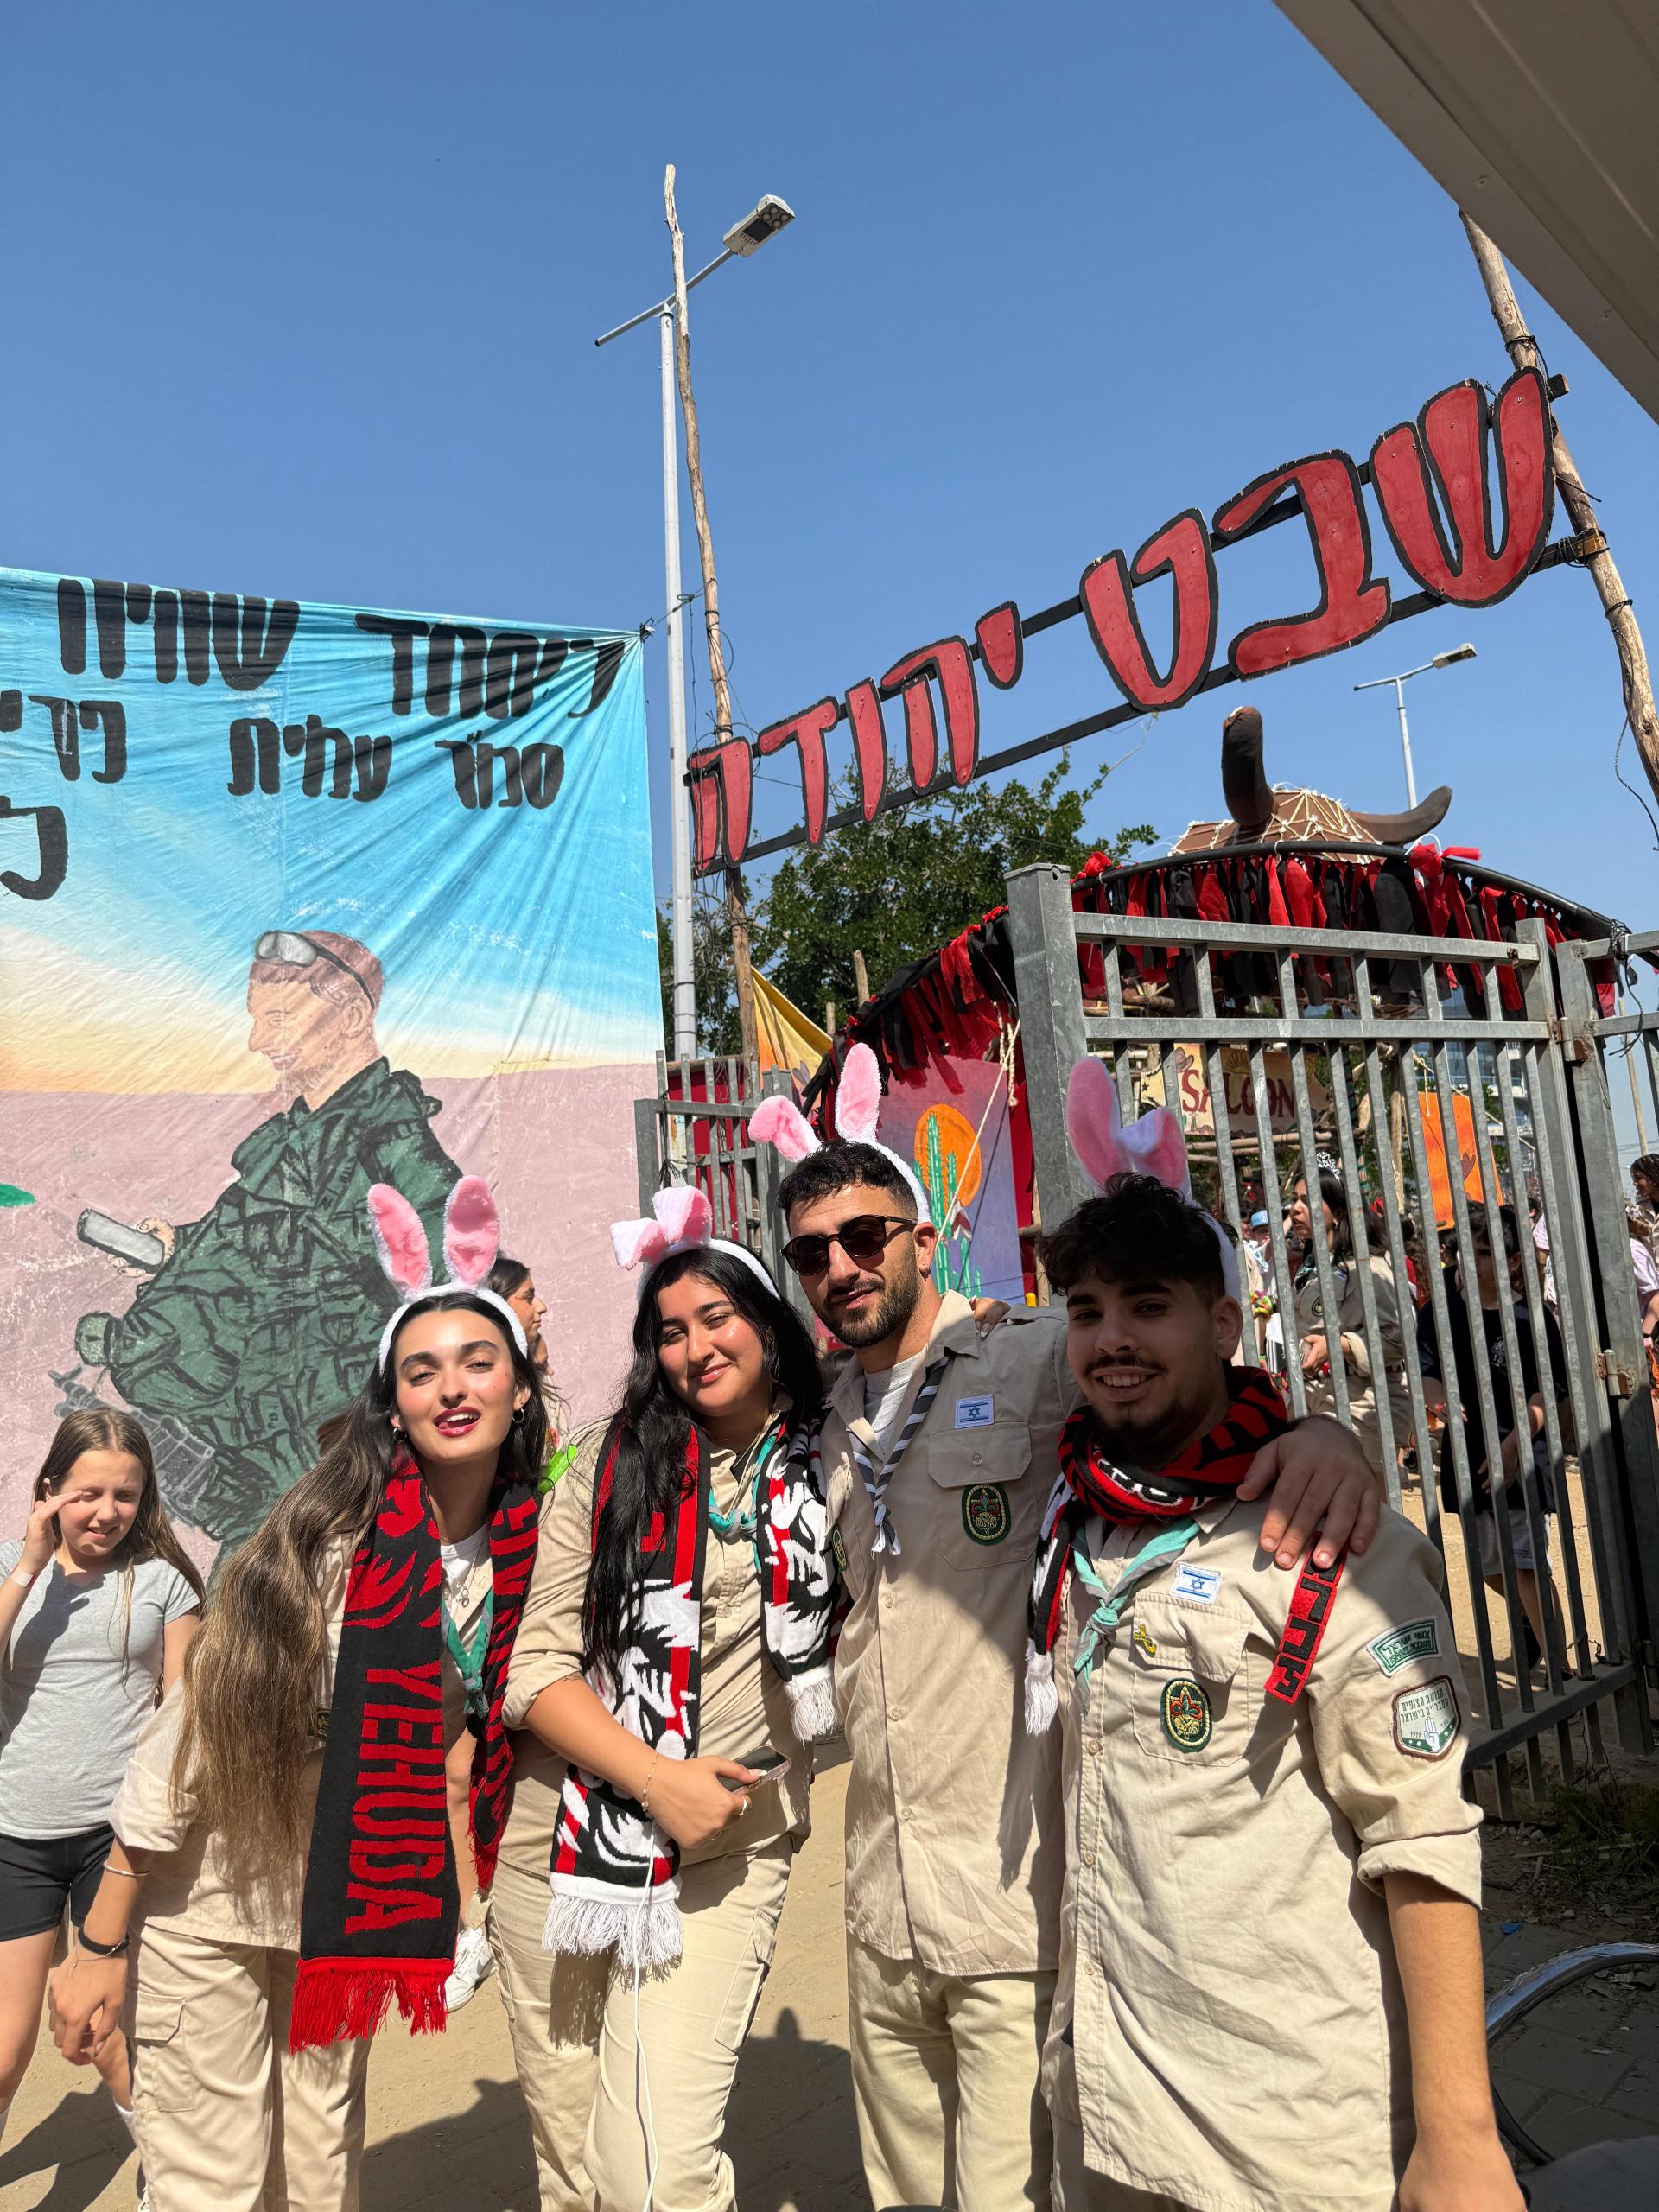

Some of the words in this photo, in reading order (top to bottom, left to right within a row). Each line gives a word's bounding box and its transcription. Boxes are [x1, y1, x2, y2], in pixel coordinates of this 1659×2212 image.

[1080, 366, 1555, 711] שבט
[227, 714, 393, 802] עמית
[687, 600, 1024, 878] יהודה
[1400, 1709, 1426, 1723] בישראל
[1401, 1697, 1425, 1711] הצופים
[1425, 1697, 1449, 1715] העבריים
[345, 1659, 446, 1936] YEHUDA
